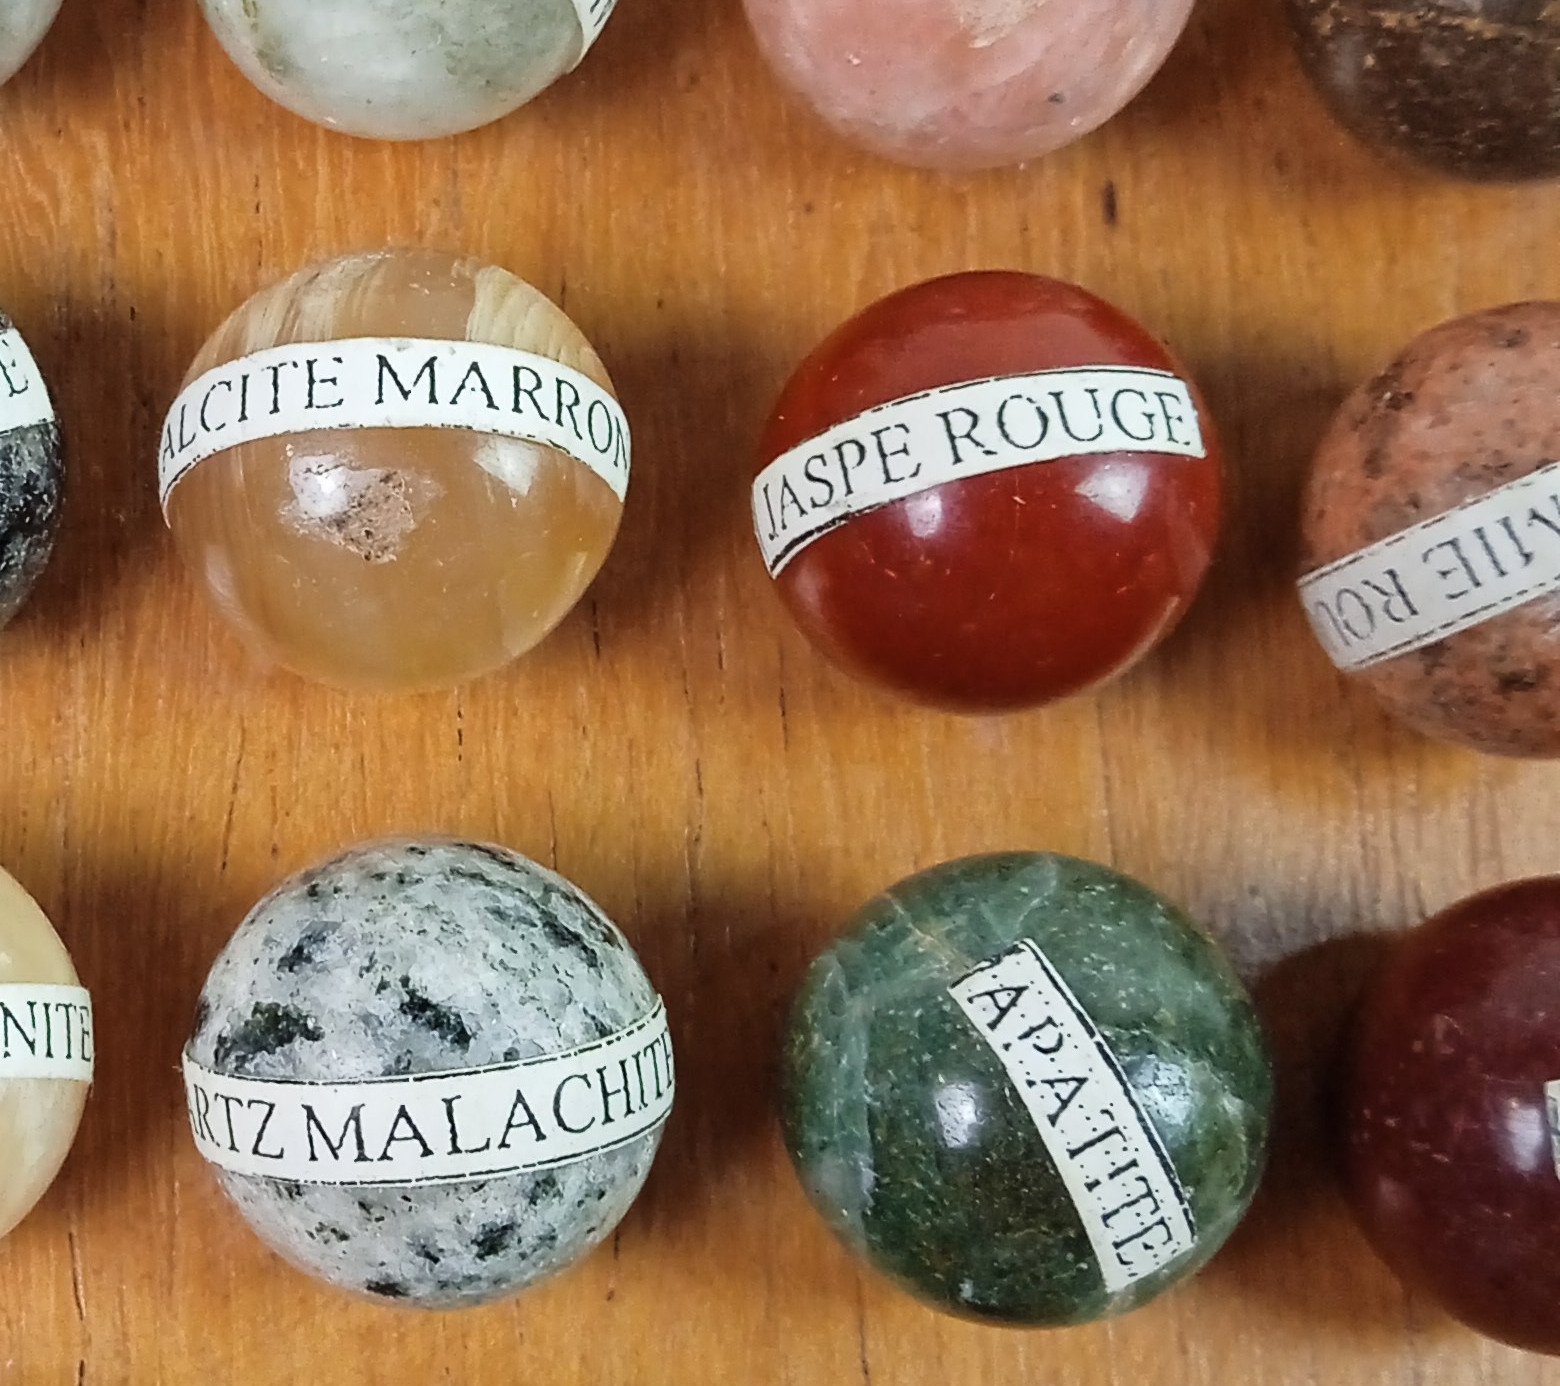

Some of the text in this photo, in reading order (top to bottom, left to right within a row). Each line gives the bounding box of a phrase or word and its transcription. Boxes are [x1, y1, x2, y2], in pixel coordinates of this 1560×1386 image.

[763, 387, 1193, 541] JASPE ROUGE
[966, 984, 1174, 1267] APATITE
